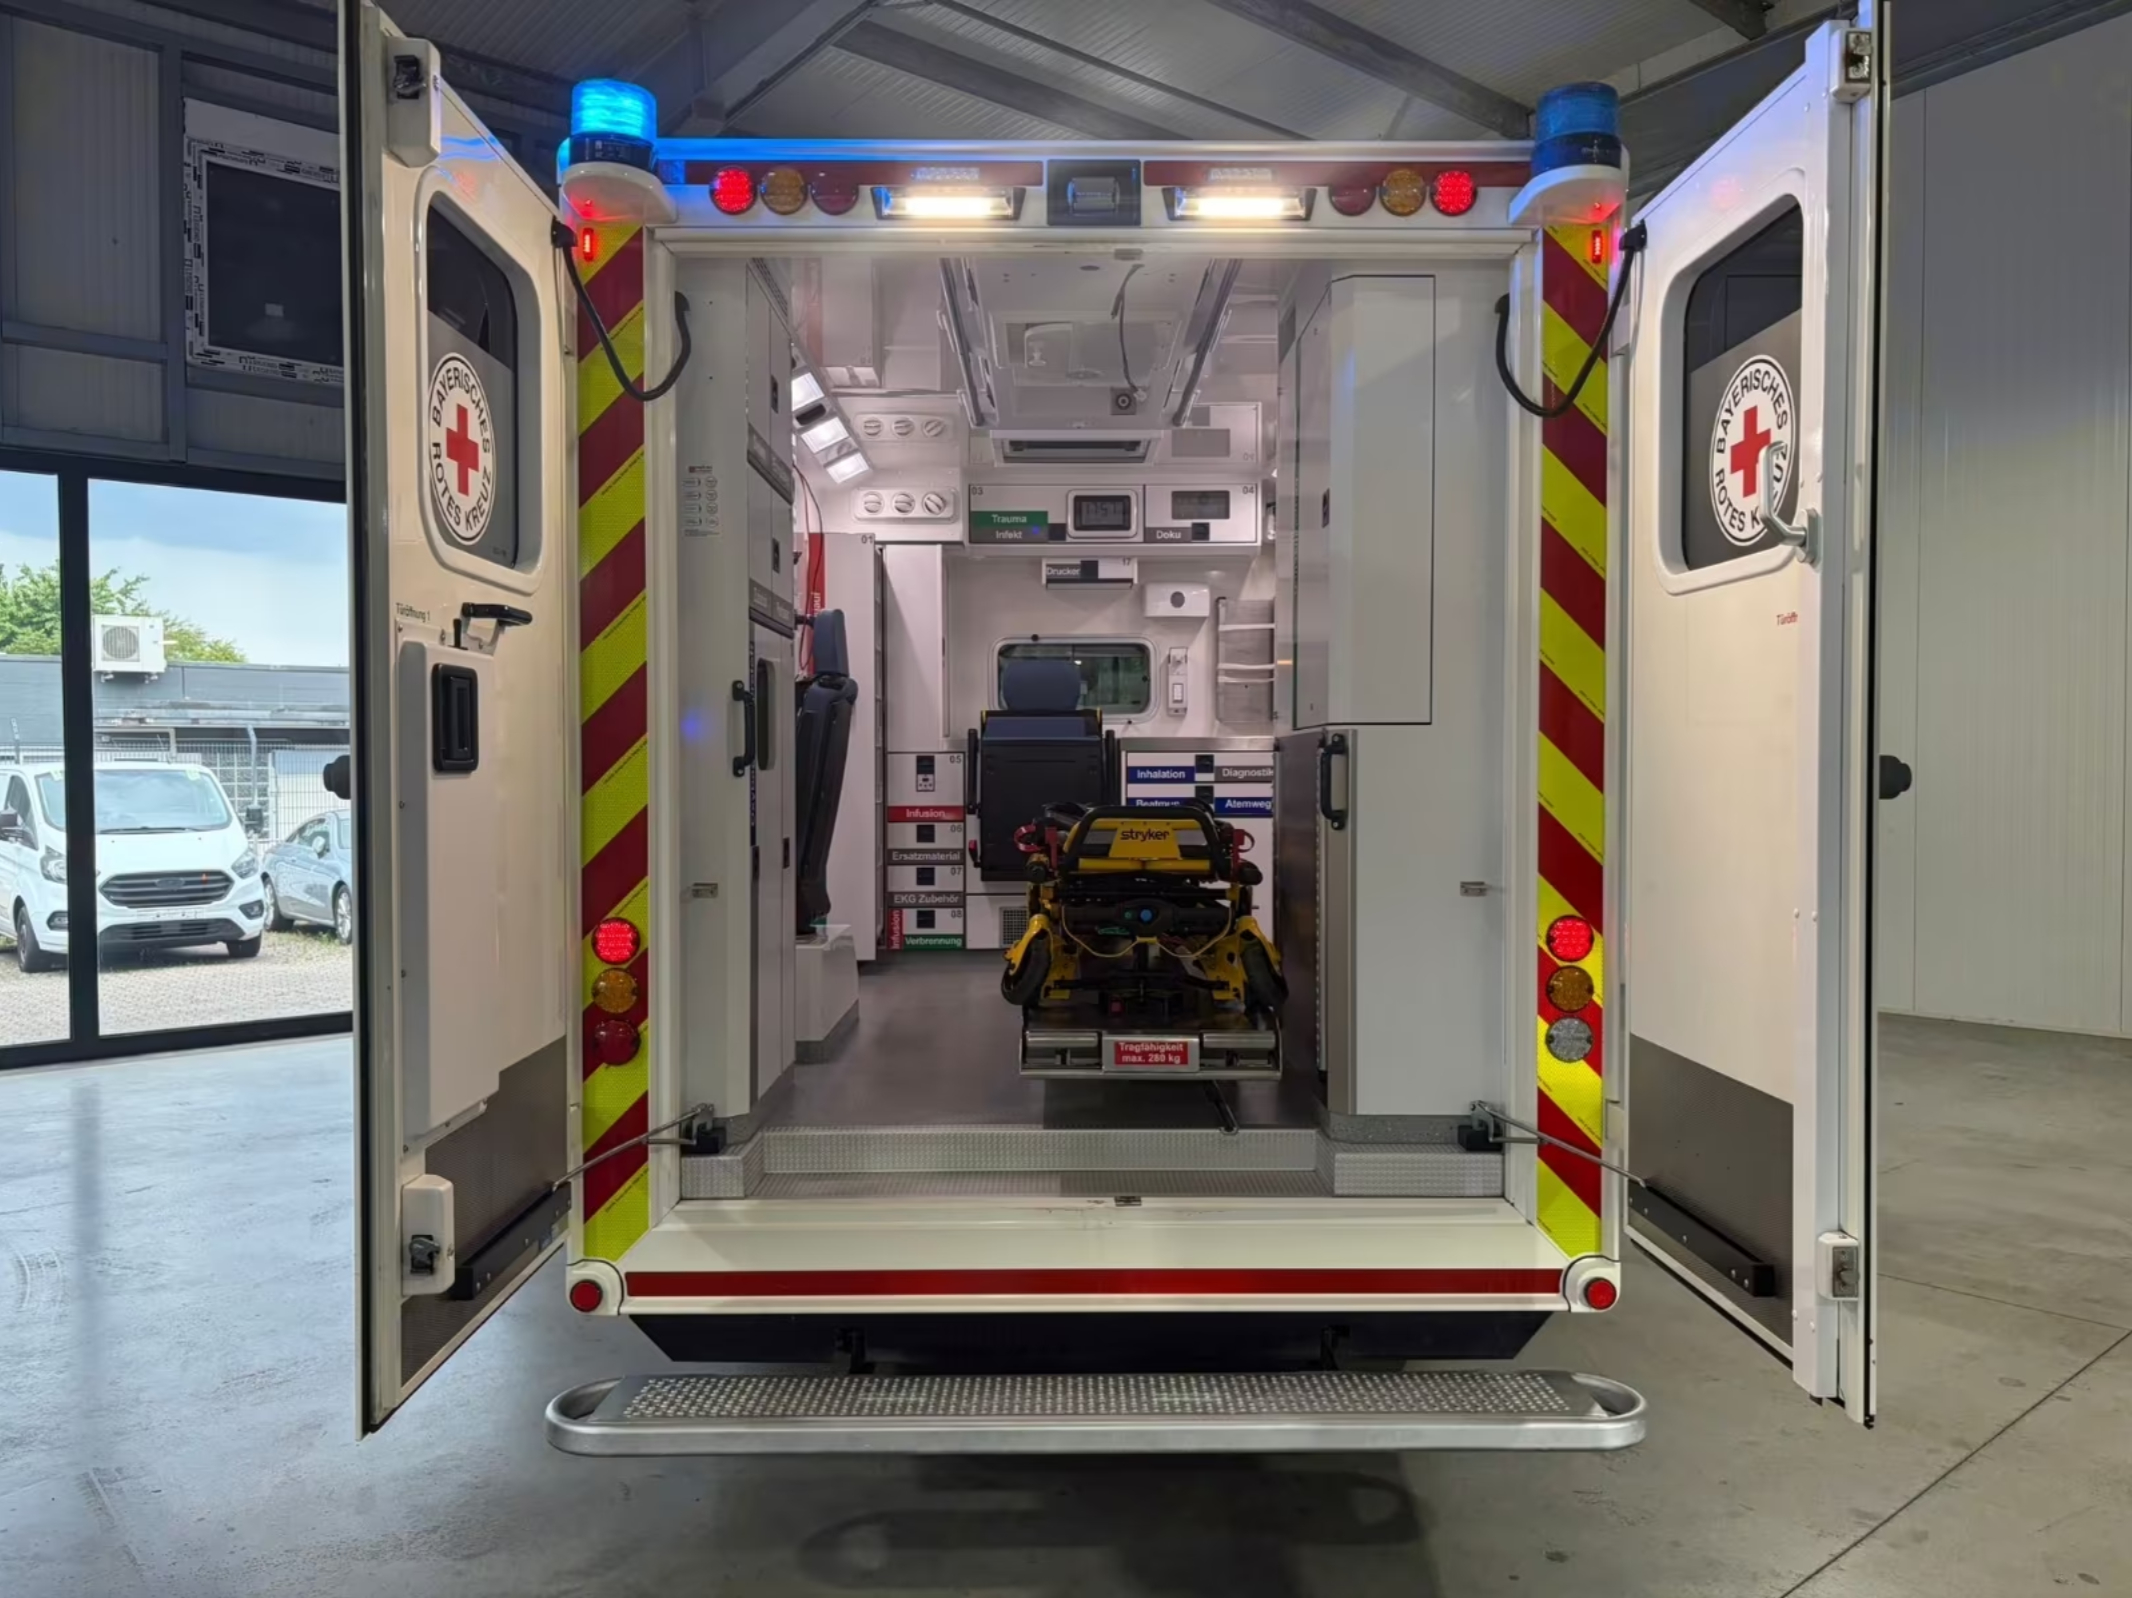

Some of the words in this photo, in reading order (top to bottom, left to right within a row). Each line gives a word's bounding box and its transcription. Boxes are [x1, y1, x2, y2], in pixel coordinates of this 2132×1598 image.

[432, 366, 490, 454] BAYERISCHES
[1716, 367, 1788, 455] BAYERISCHES
[432, 442, 461, 527] ROTES
[464, 465, 491, 532] KREUZ
[971, 486, 984, 496] 03
[1242, 485, 1255, 495] 04
[1715, 467, 1746, 532] ROTES
[1751, 442, 1788, 530] KUZ
[991, 513, 1027, 524] Trauma
[995, 530, 1023, 539] Infekt
[1156, 530, 1181, 539] Doku
[1046, 566, 1081, 576] Drucker
[949, 755, 962, 764] 05
[1136, 768, 1186, 779] Inhalation
[1221, 767, 1274, 779] Diagnostik
[905, 808, 946, 818] Infusion
[1120, 828, 1170, 842] stryker
[892, 851, 960, 861] Ersatzmaterial
[893, 893, 916, 903] EKG
[918, 893, 959, 903] Zubehör
[891, 909, 900, 950] Infusion
[905, 937, 963, 948] Verbrennung
[1119, 1042, 1184, 1053] Tragfähigkeit
[1121, 1055, 1146, 1063] max.
[1168, 1053, 1181, 1065] kg
